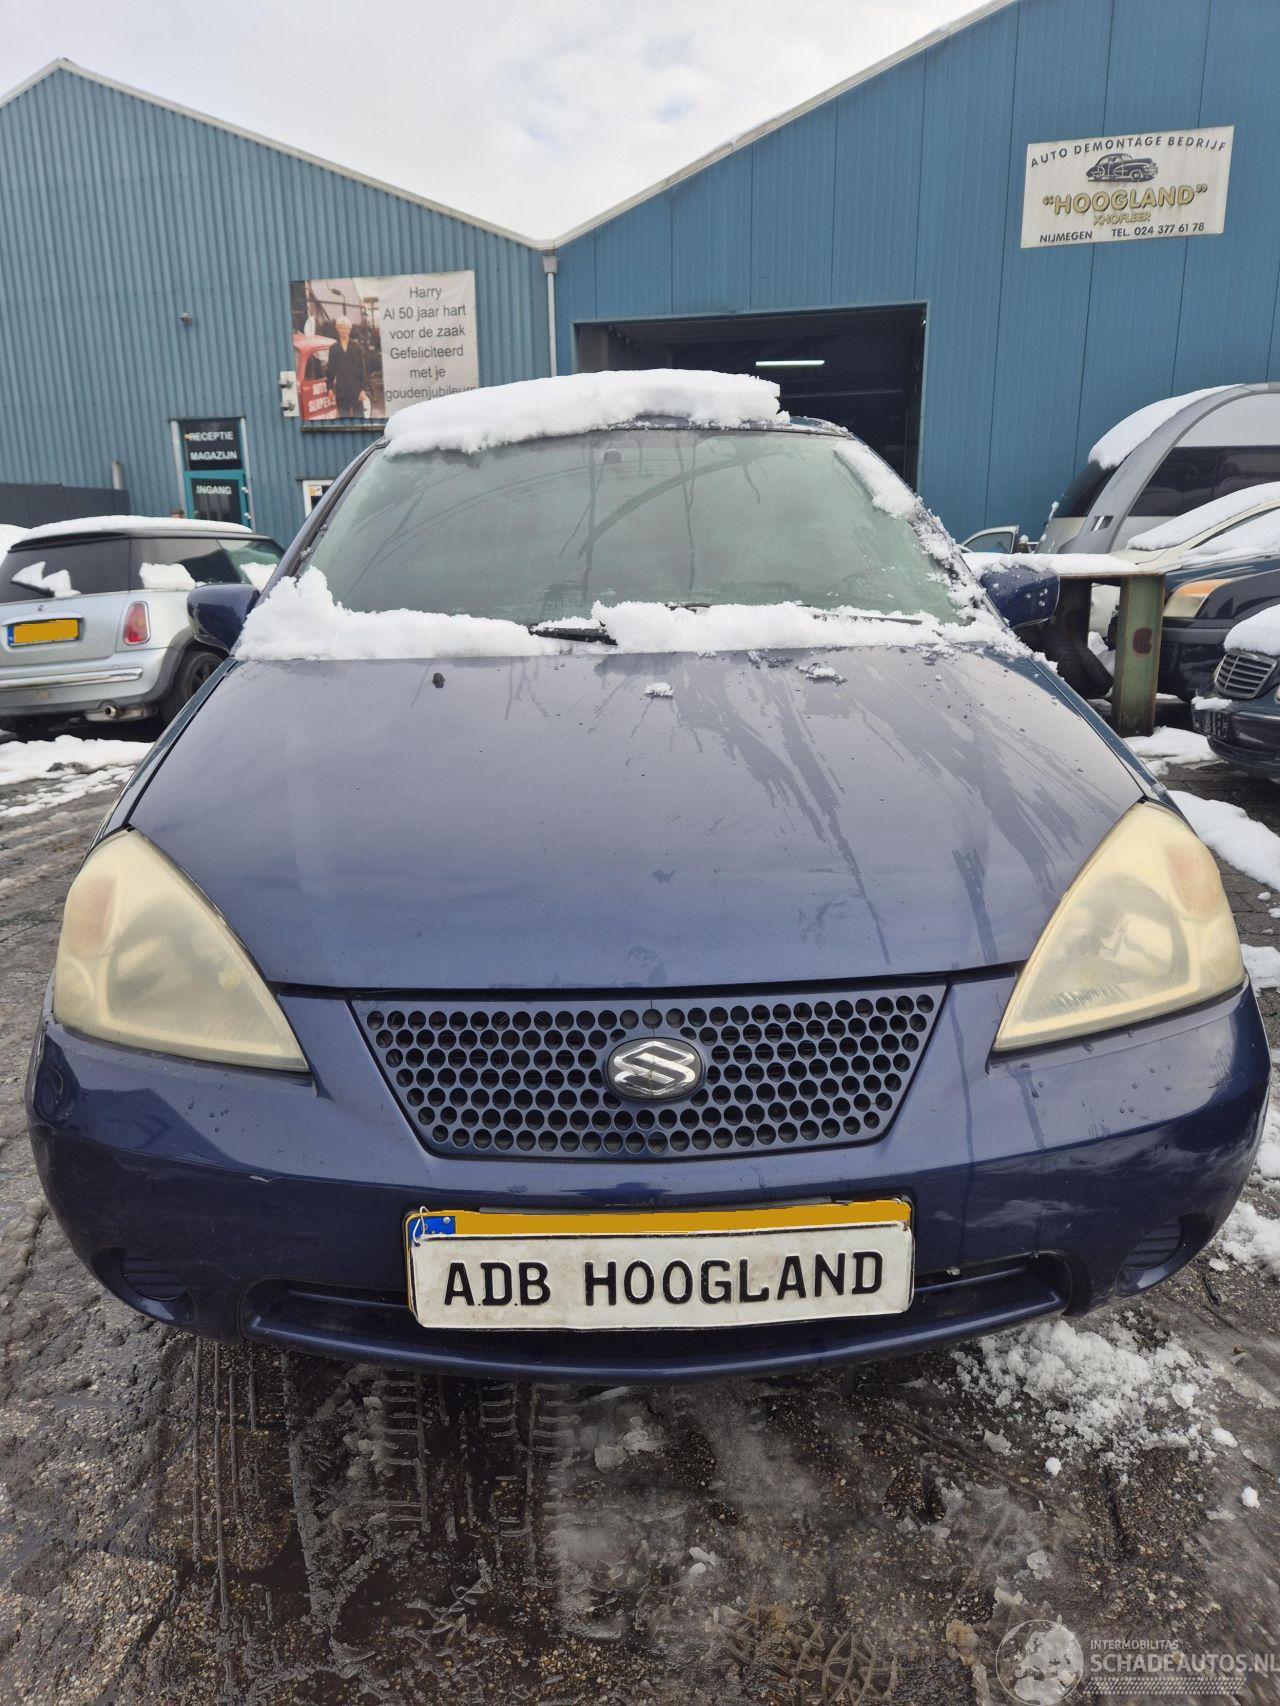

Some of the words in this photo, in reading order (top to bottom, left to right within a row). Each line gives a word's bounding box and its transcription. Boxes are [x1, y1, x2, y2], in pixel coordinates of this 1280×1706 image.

[1031, 149, 1068, 168] AUTO
[1074, 135, 1162, 155] DEMONTAGE
[1167, 136, 1226, 151] BEDRIJF
[1039, 230, 1093, 244] NIJMEGEN
[1112, 228, 1130, 238] TEL.
[1134, 226, 1154, 236] 024
[1157, 224, 1175, 235] 377
[1178, 223, 1189, 233] 61
[1192, 222, 1205, 232] 78
[409, 286, 442, 302] Harry
[383, 308, 395, 320] Al
[399, 307, 414, 319] 50
[416, 306, 439, 321] jaar
[443, 305, 466, 316] hart
[389, 329, 415, 339] voor
[419, 326, 433, 338] de
[437, 325, 466, 337] zaak
[390, 345, 464, 360] Gefeliciteerd
[409, 366, 431, 379] met
[434, 366, 446, 381] je
[189, 431, 234, 441] RECEPTIE
[190, 450, 238, 461] MAGAZIJN
[196, 484, 232, 495] INGANG
[584, 1250, 885, 1307] HOOGLAND
